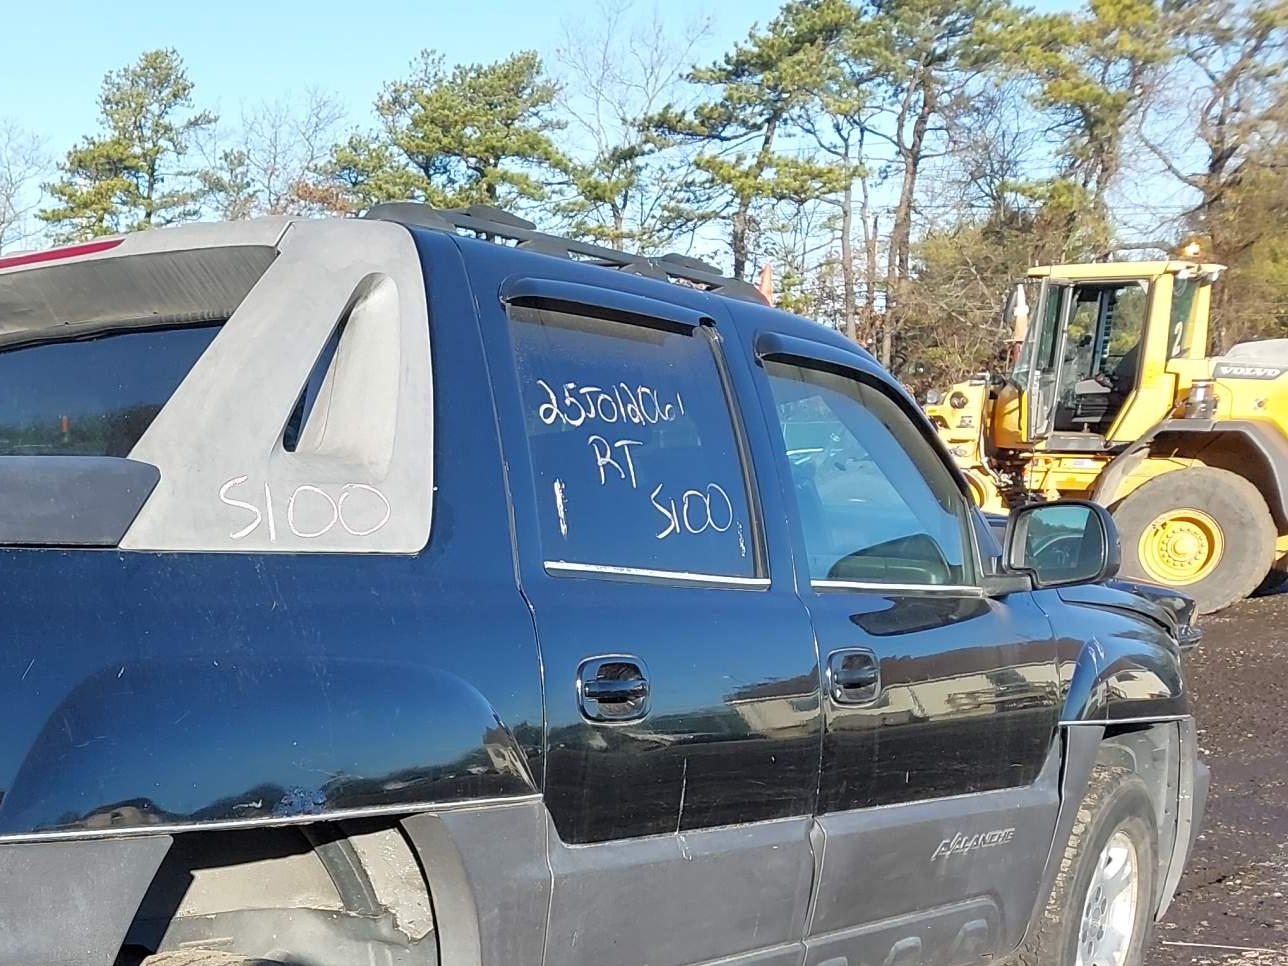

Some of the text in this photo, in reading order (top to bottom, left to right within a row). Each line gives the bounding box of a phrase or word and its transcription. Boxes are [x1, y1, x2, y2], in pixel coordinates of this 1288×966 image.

[1220, 366, 1281, 377] VOLVO
[588, 435, 644, 489] RT
[219, 475, 391, 542] S100
[650, 483, 733, 539] S100
